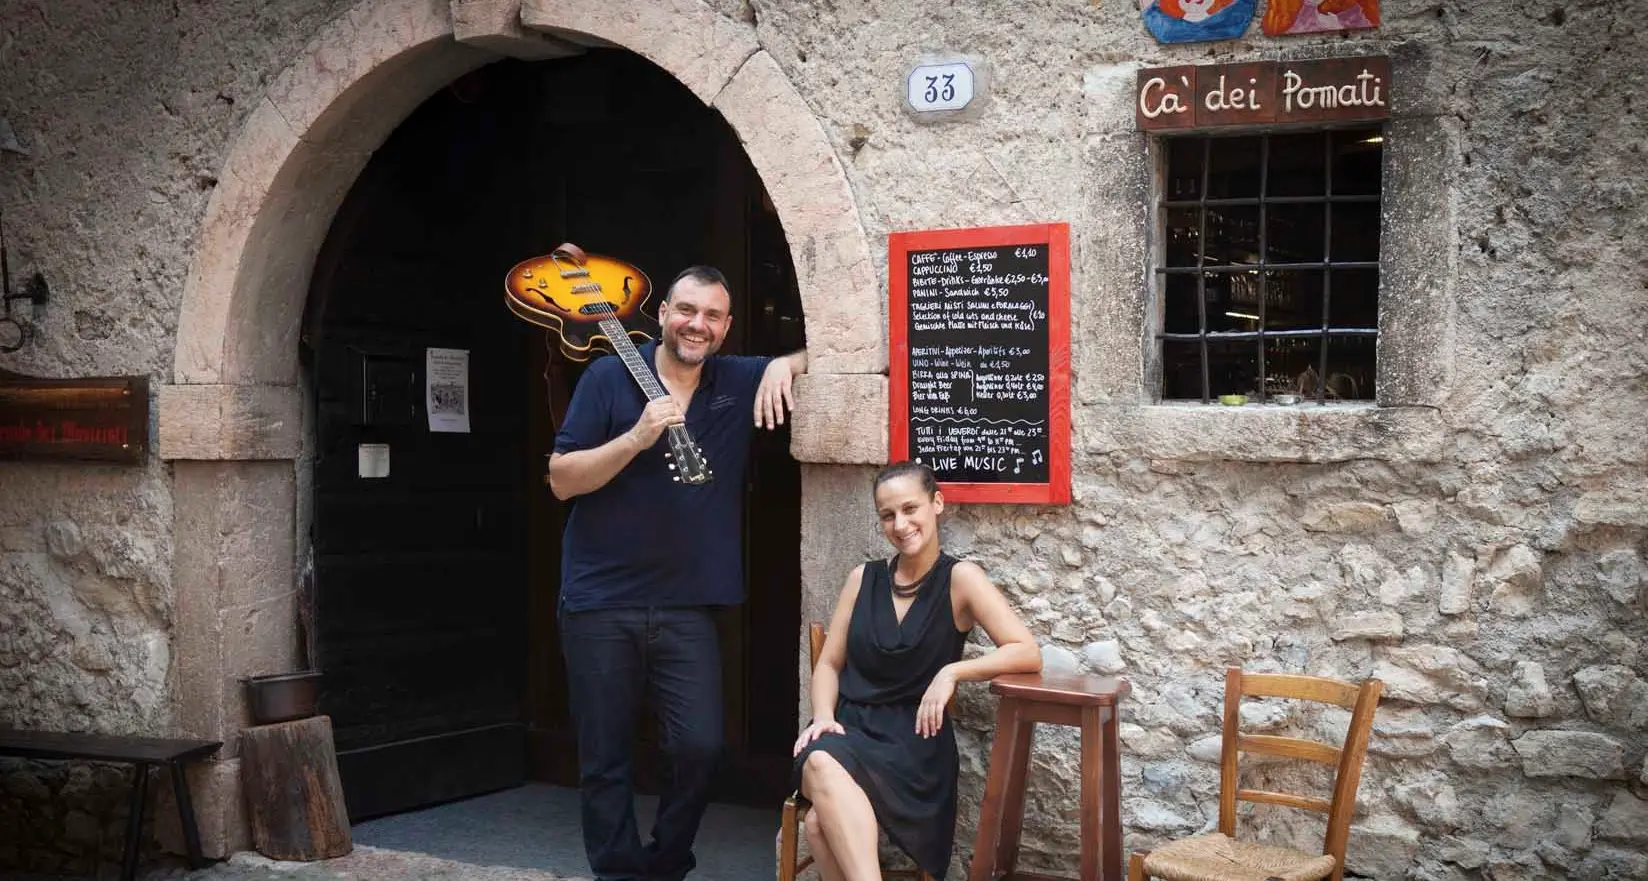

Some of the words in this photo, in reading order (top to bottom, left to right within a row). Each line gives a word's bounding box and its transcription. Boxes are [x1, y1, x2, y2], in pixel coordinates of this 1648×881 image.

[924, 74, 955, 103] 33
[1204, 74, 1261, 111] dei
[1282, 69, 1385, 113] Pomati
[942, 252, 963, 265] Coffee
[968, 251, 997, 264] Espresso
[913, 264, 958, 276] CAPPUCCINO
[912, 277, 936, 287] BIBITE
[912, 288, 938, 298] PANINI
[945, 287, 979, 298] Sandwich
[981, 312, 995, 320] and
[912, 370, 933, 379] BIRRA
[912, 406, 929, 414] LONG
[932, 457, 958, 471] LIVE
[964, 456, 1007, 472] MUSIC
